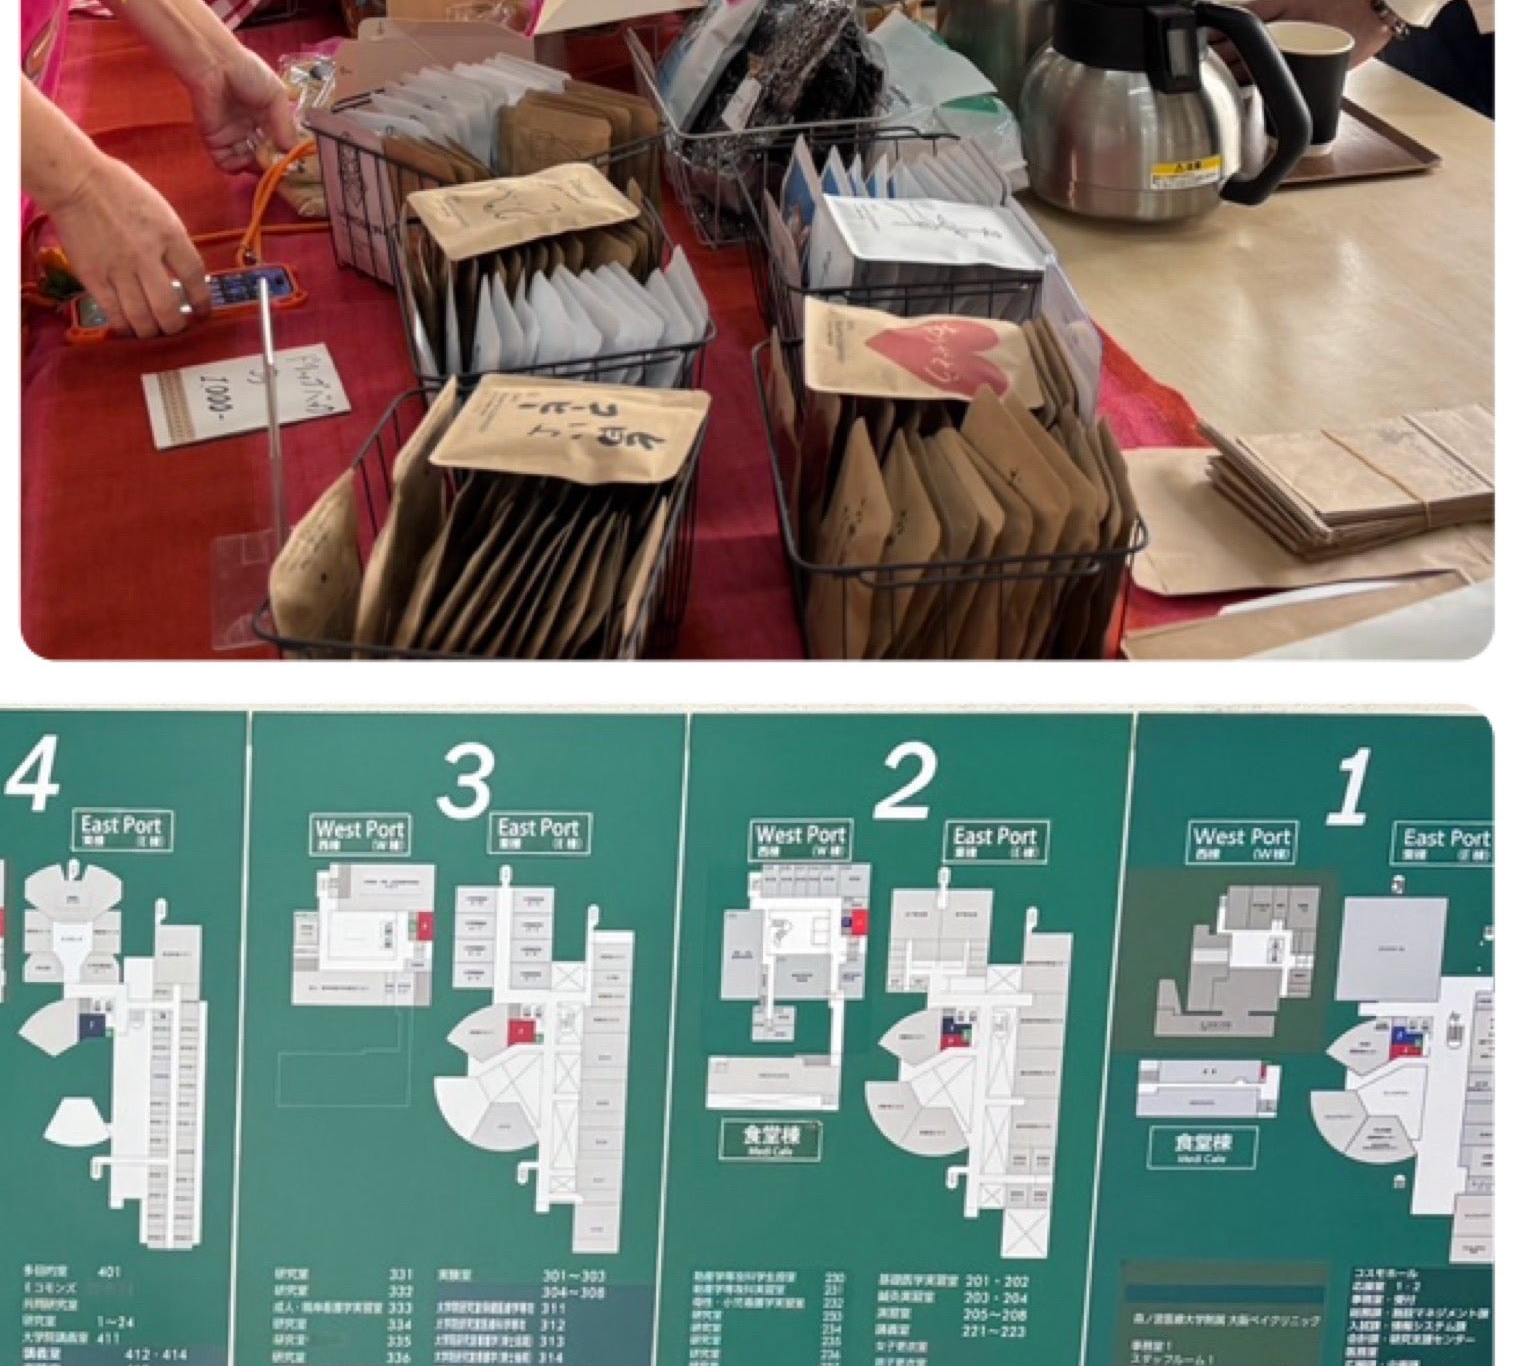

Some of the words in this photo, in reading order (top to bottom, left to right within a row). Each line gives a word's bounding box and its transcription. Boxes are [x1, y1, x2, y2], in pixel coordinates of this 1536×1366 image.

[4, 733, 61, 812] 4
[436, 742, 497, 822] 3
[872, 741, 939, 820] 2
[1326, 747, 1372, 826] 1
[81, 816, 118, 834] East
[124, 816, 162, 835] Port
[316, 819, 363, 838] West
[367, 820, 405, 839] Port
[498, 817, 536, 836] East
[541, 817, 580, 837] Port
[756, 824, 803, 844] West
[808, 824, 847, 845] Port
[954, 826, 992, 845] East
[997, 826, 1037, 846] Port
[1193, 826, 1241, 846] West
[1247, 826, 1291, 847] Port
[1404, 828, 1445, 847] East
[1451, 828, 1492, 848] Port
[743, 1125, 801, 1146] 食堂棟
[1175, 1133, 1233, 1153] 食堂棟
